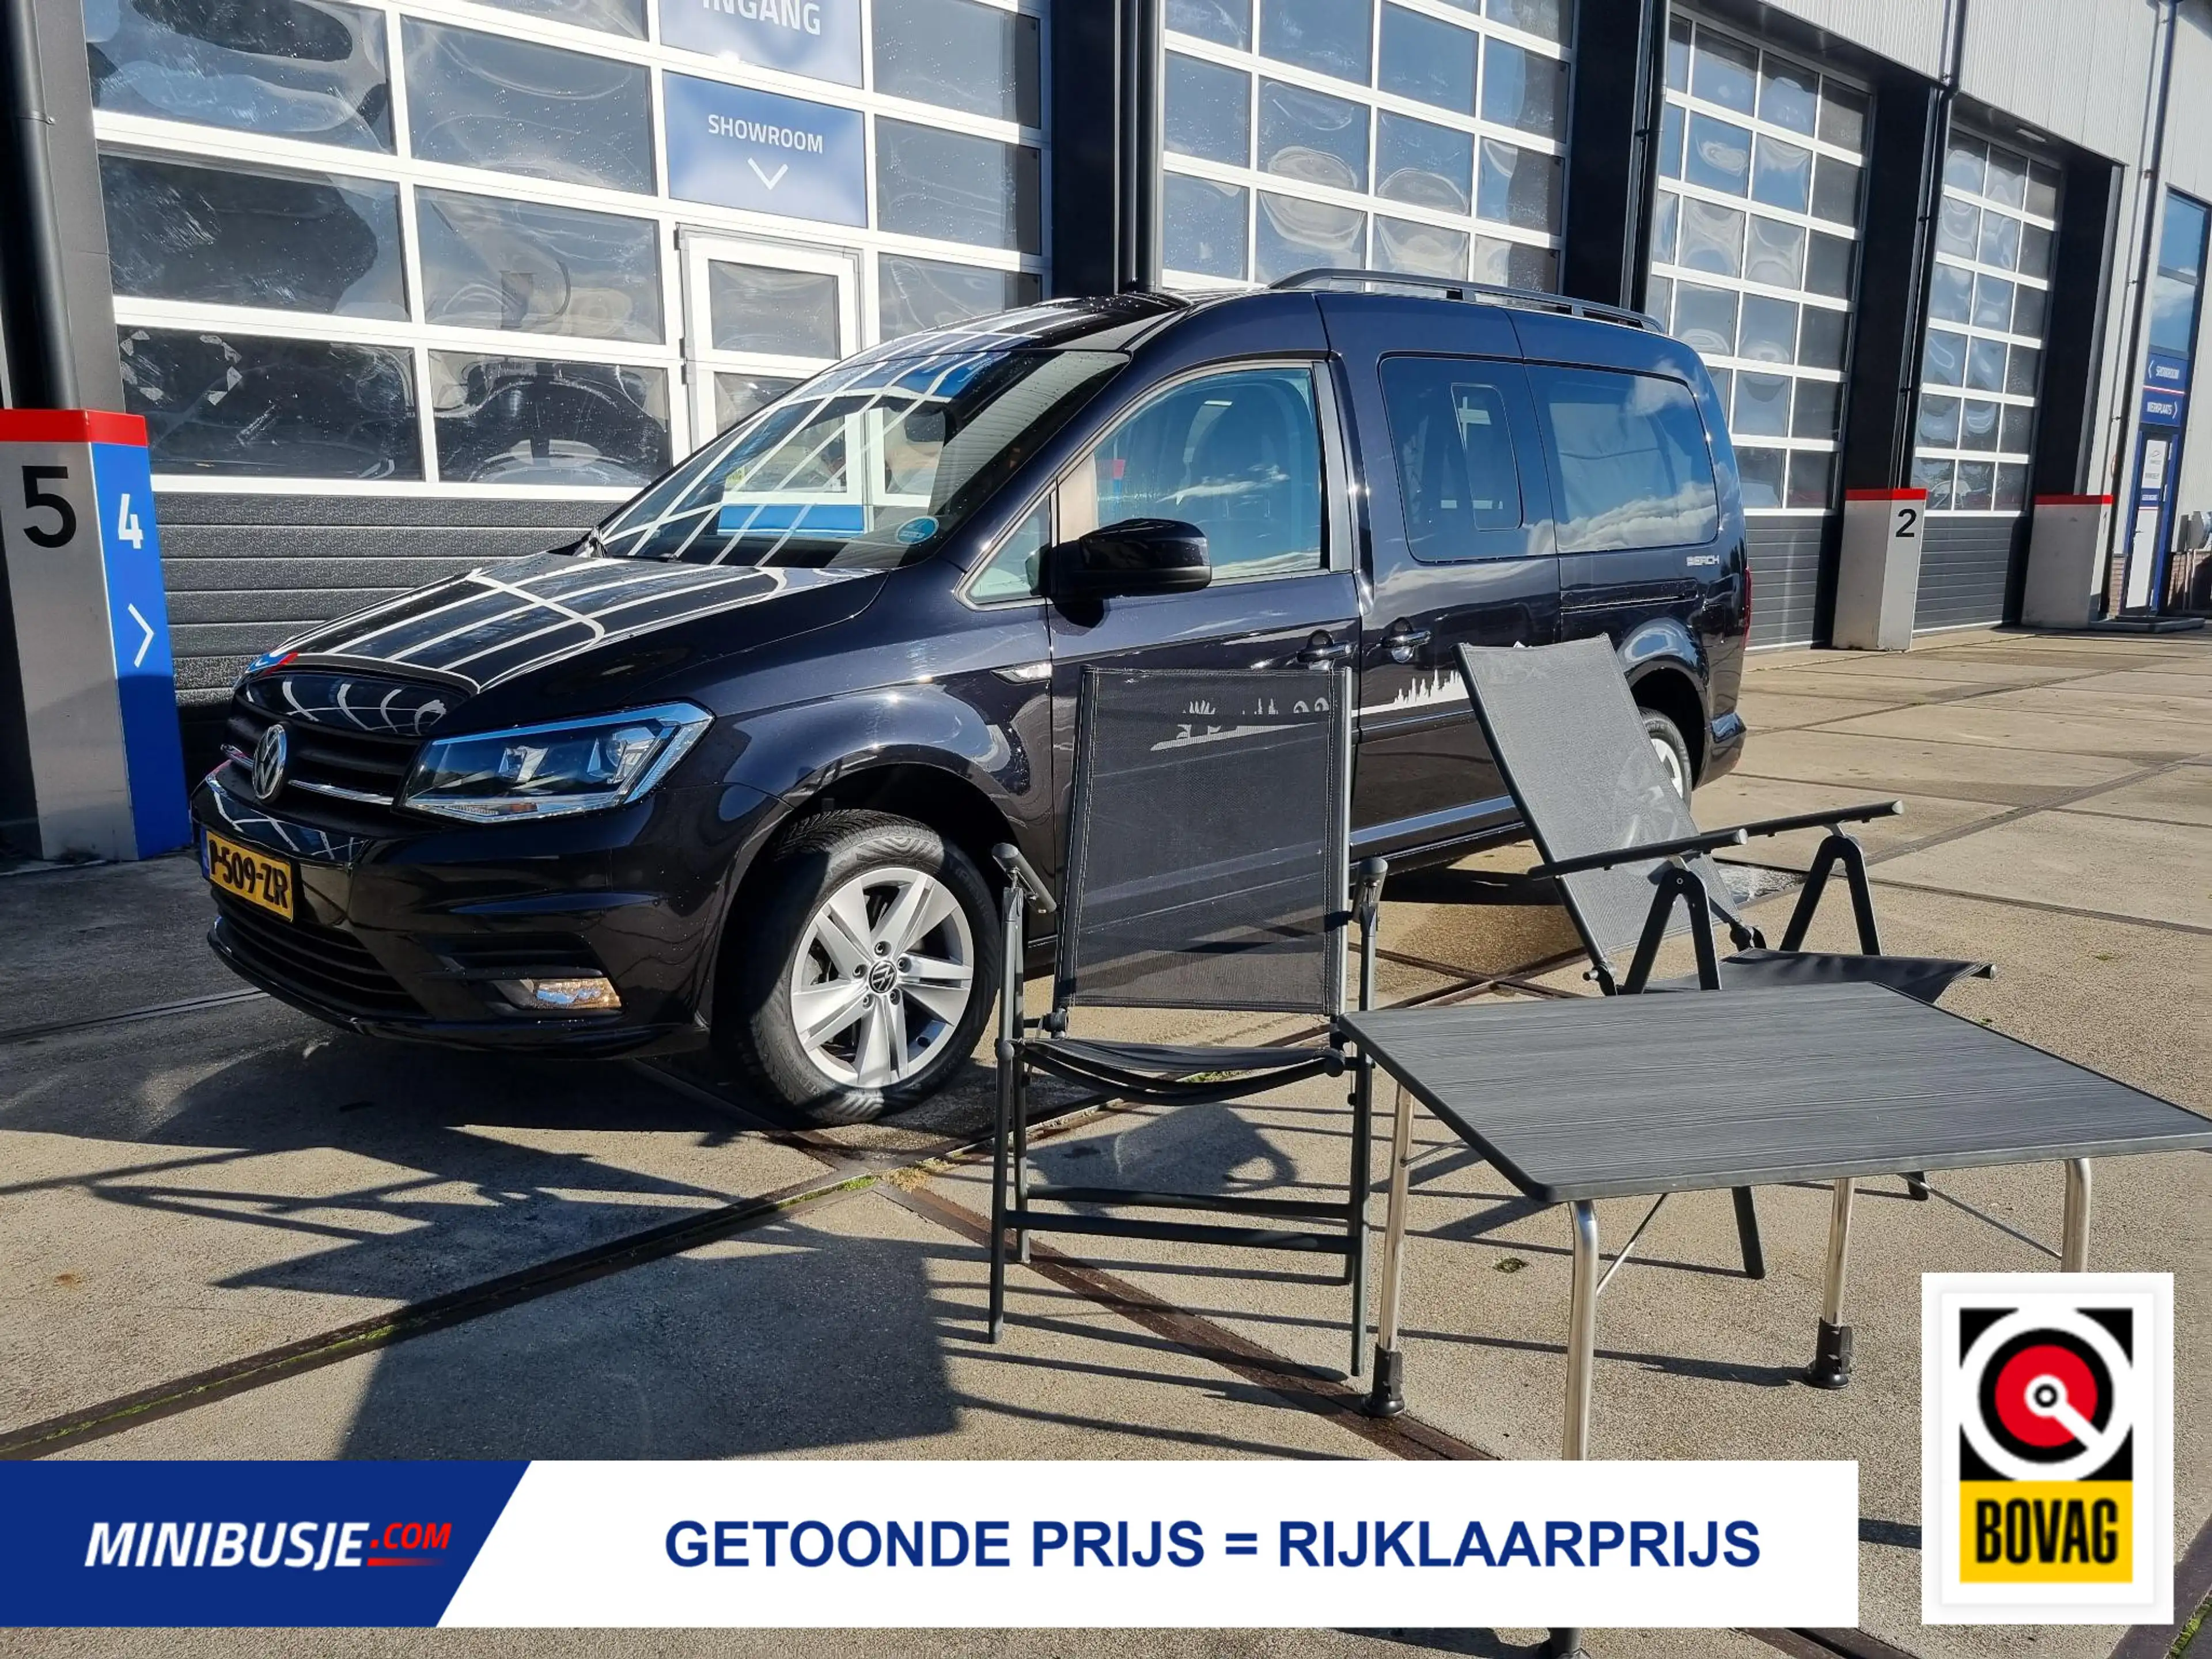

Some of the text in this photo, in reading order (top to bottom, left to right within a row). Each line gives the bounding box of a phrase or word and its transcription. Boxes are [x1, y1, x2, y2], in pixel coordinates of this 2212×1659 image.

[703, 0, 821, 35] GANG
[709, 114, 823, 154] SHOWROOM
[21, 465, 77, 549] 5
[117, 494, 144, 549] 4
[1896, 509, 1918, 538] 2
